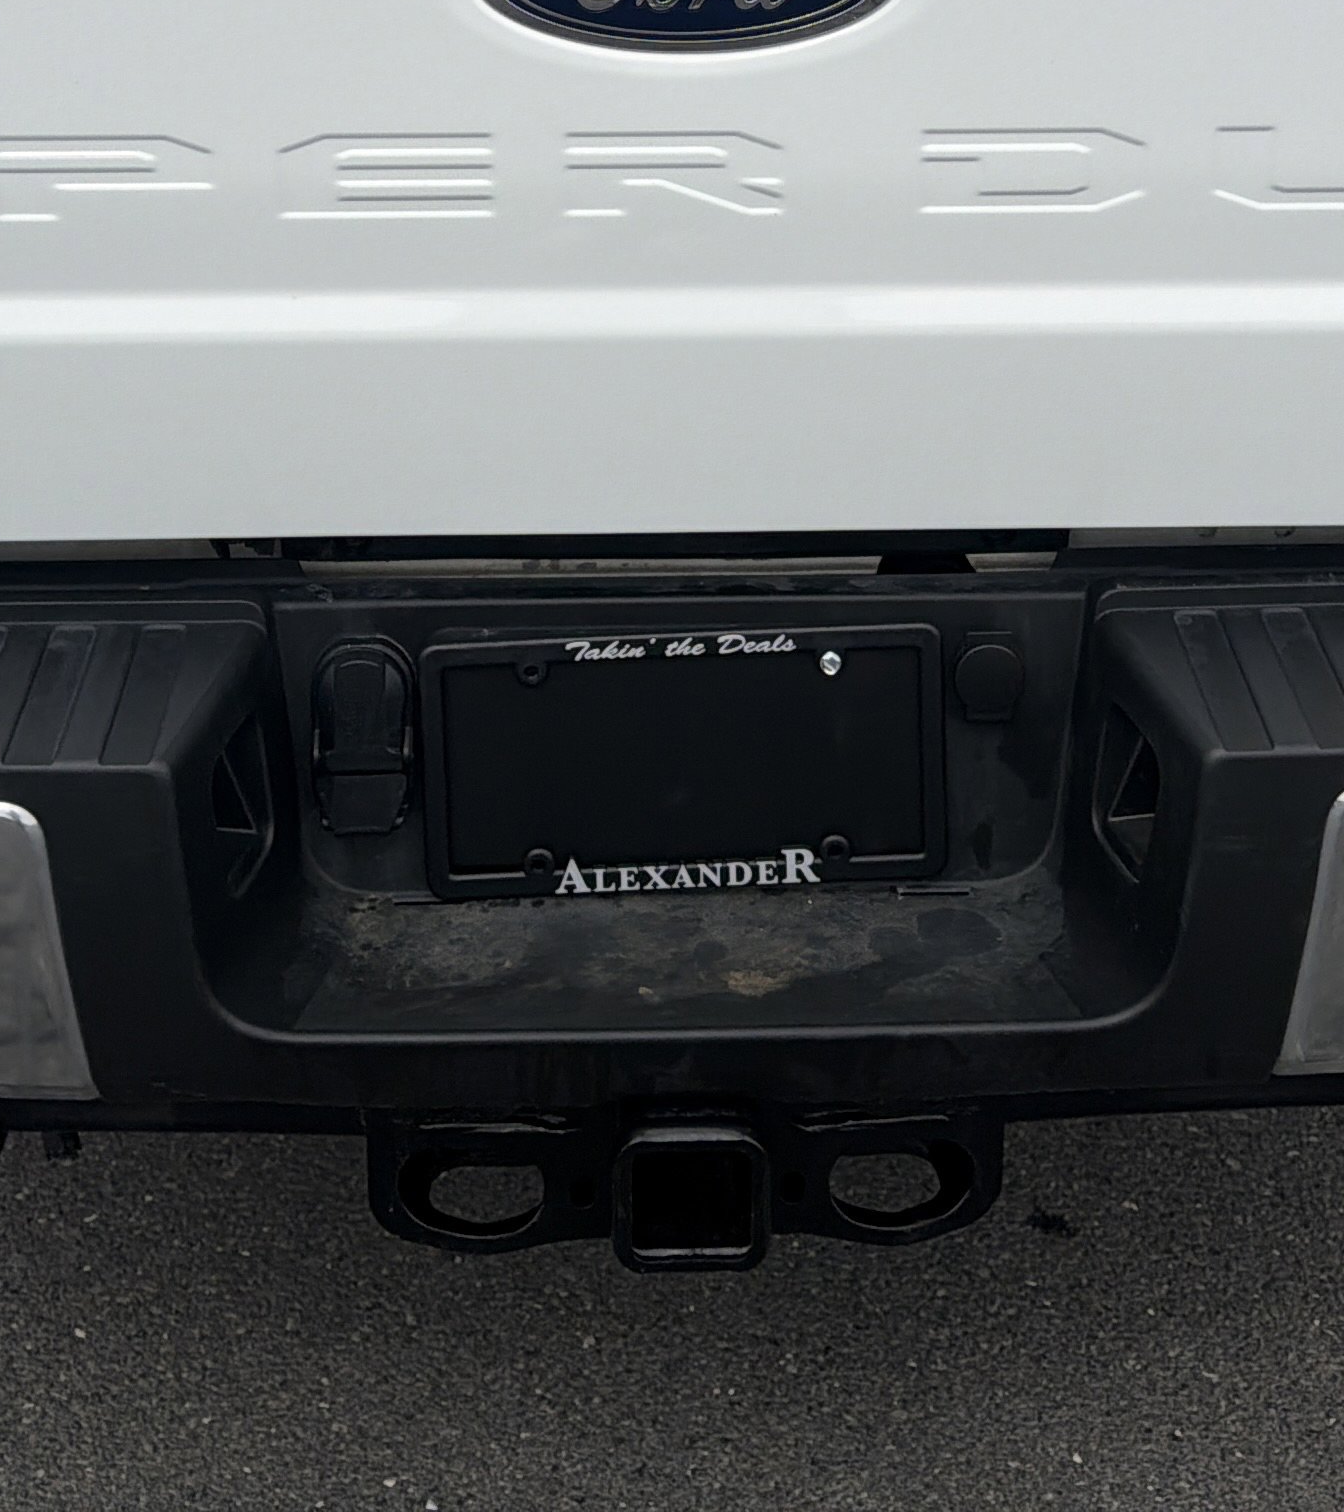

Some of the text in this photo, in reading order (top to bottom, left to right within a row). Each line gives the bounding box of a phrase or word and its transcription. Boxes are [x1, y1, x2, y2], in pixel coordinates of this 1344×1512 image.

[564, 633, 798, 662] Takin' the Deals
[555, 847, 821, 895] ALEXANDER
